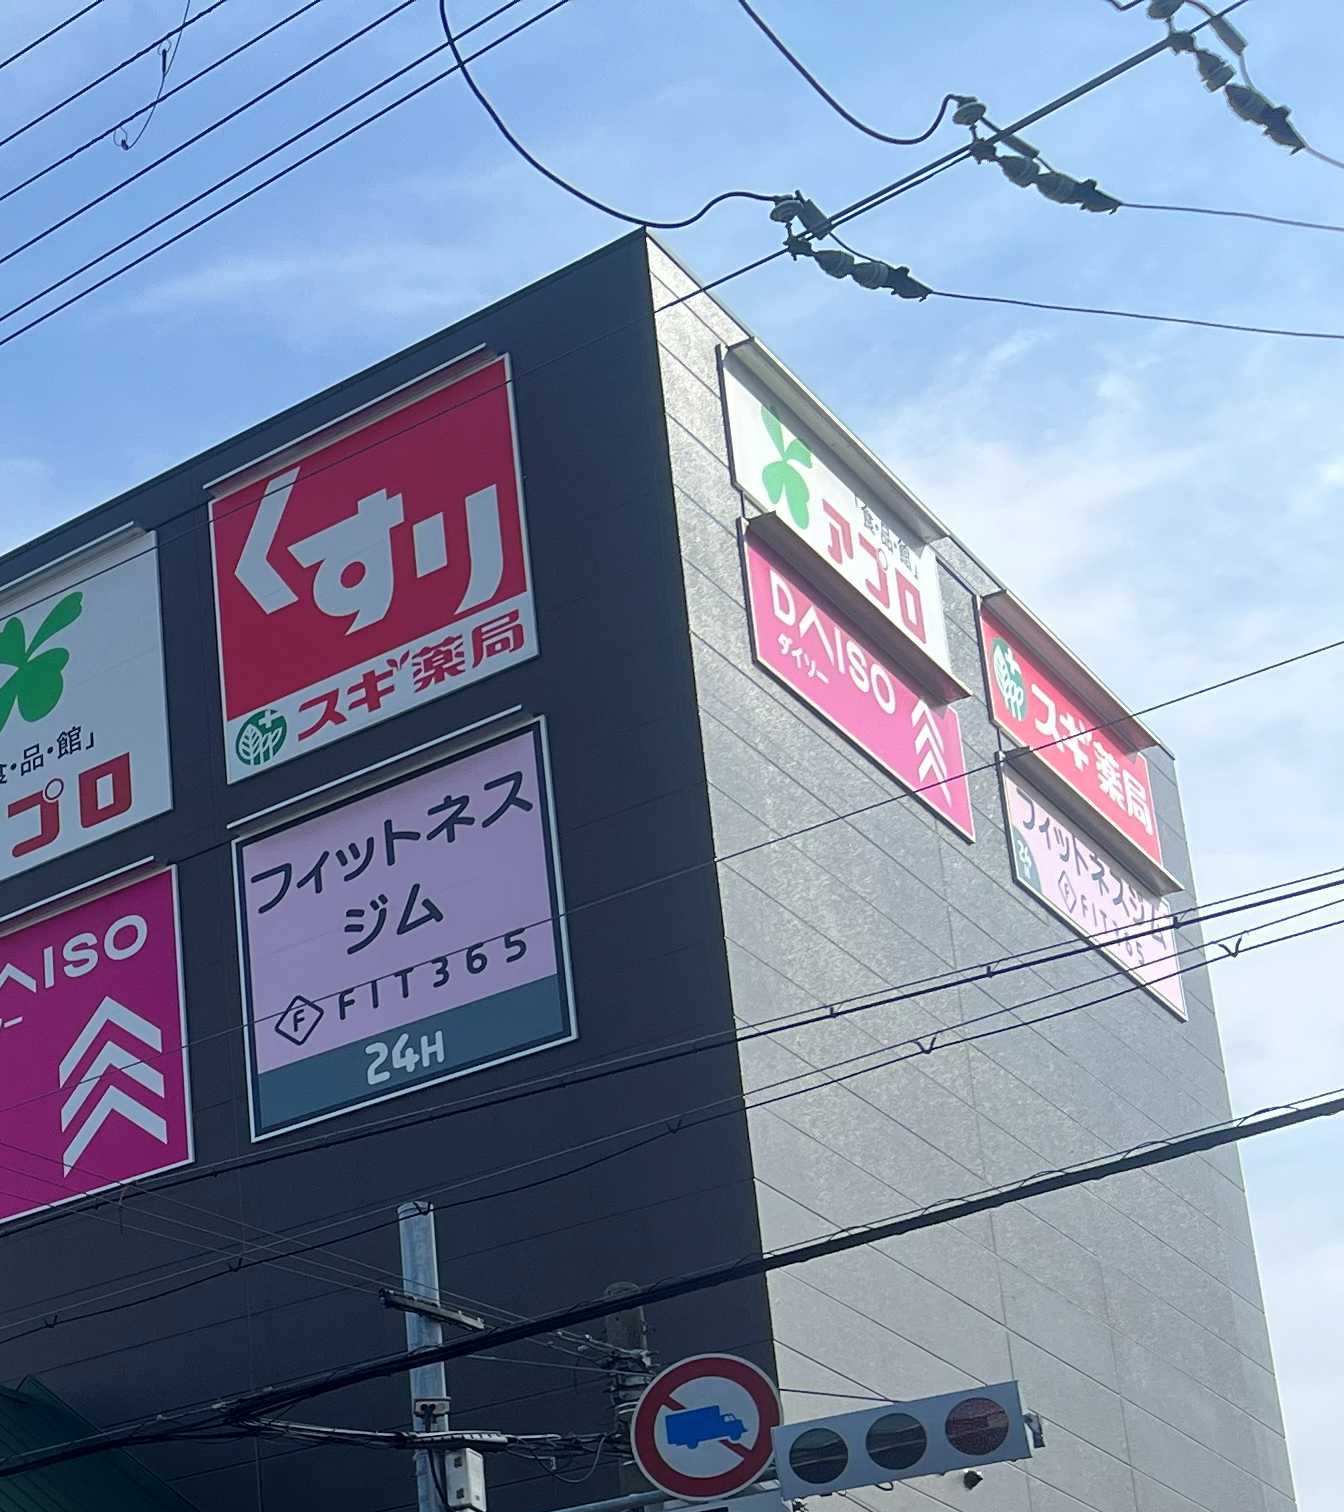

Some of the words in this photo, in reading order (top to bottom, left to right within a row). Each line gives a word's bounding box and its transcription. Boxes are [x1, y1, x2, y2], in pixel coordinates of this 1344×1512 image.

[234, 467, 507, 634] くすり
[821, 498, 927, 645] アプロ
[296, 608, 526, 741] スギ薬局
[768, 570, 895, 714] DAISO
[777, 632, 829, 685] ダイソー
[1032, 682, 1153, 835] スギ薬局
[251, 770, 532, 913] フィットネス
[338, 930, 528, 1021] FIT365
[343, 886, 444, 955] ジム
[365, 1030, 445, 1084] 24H
